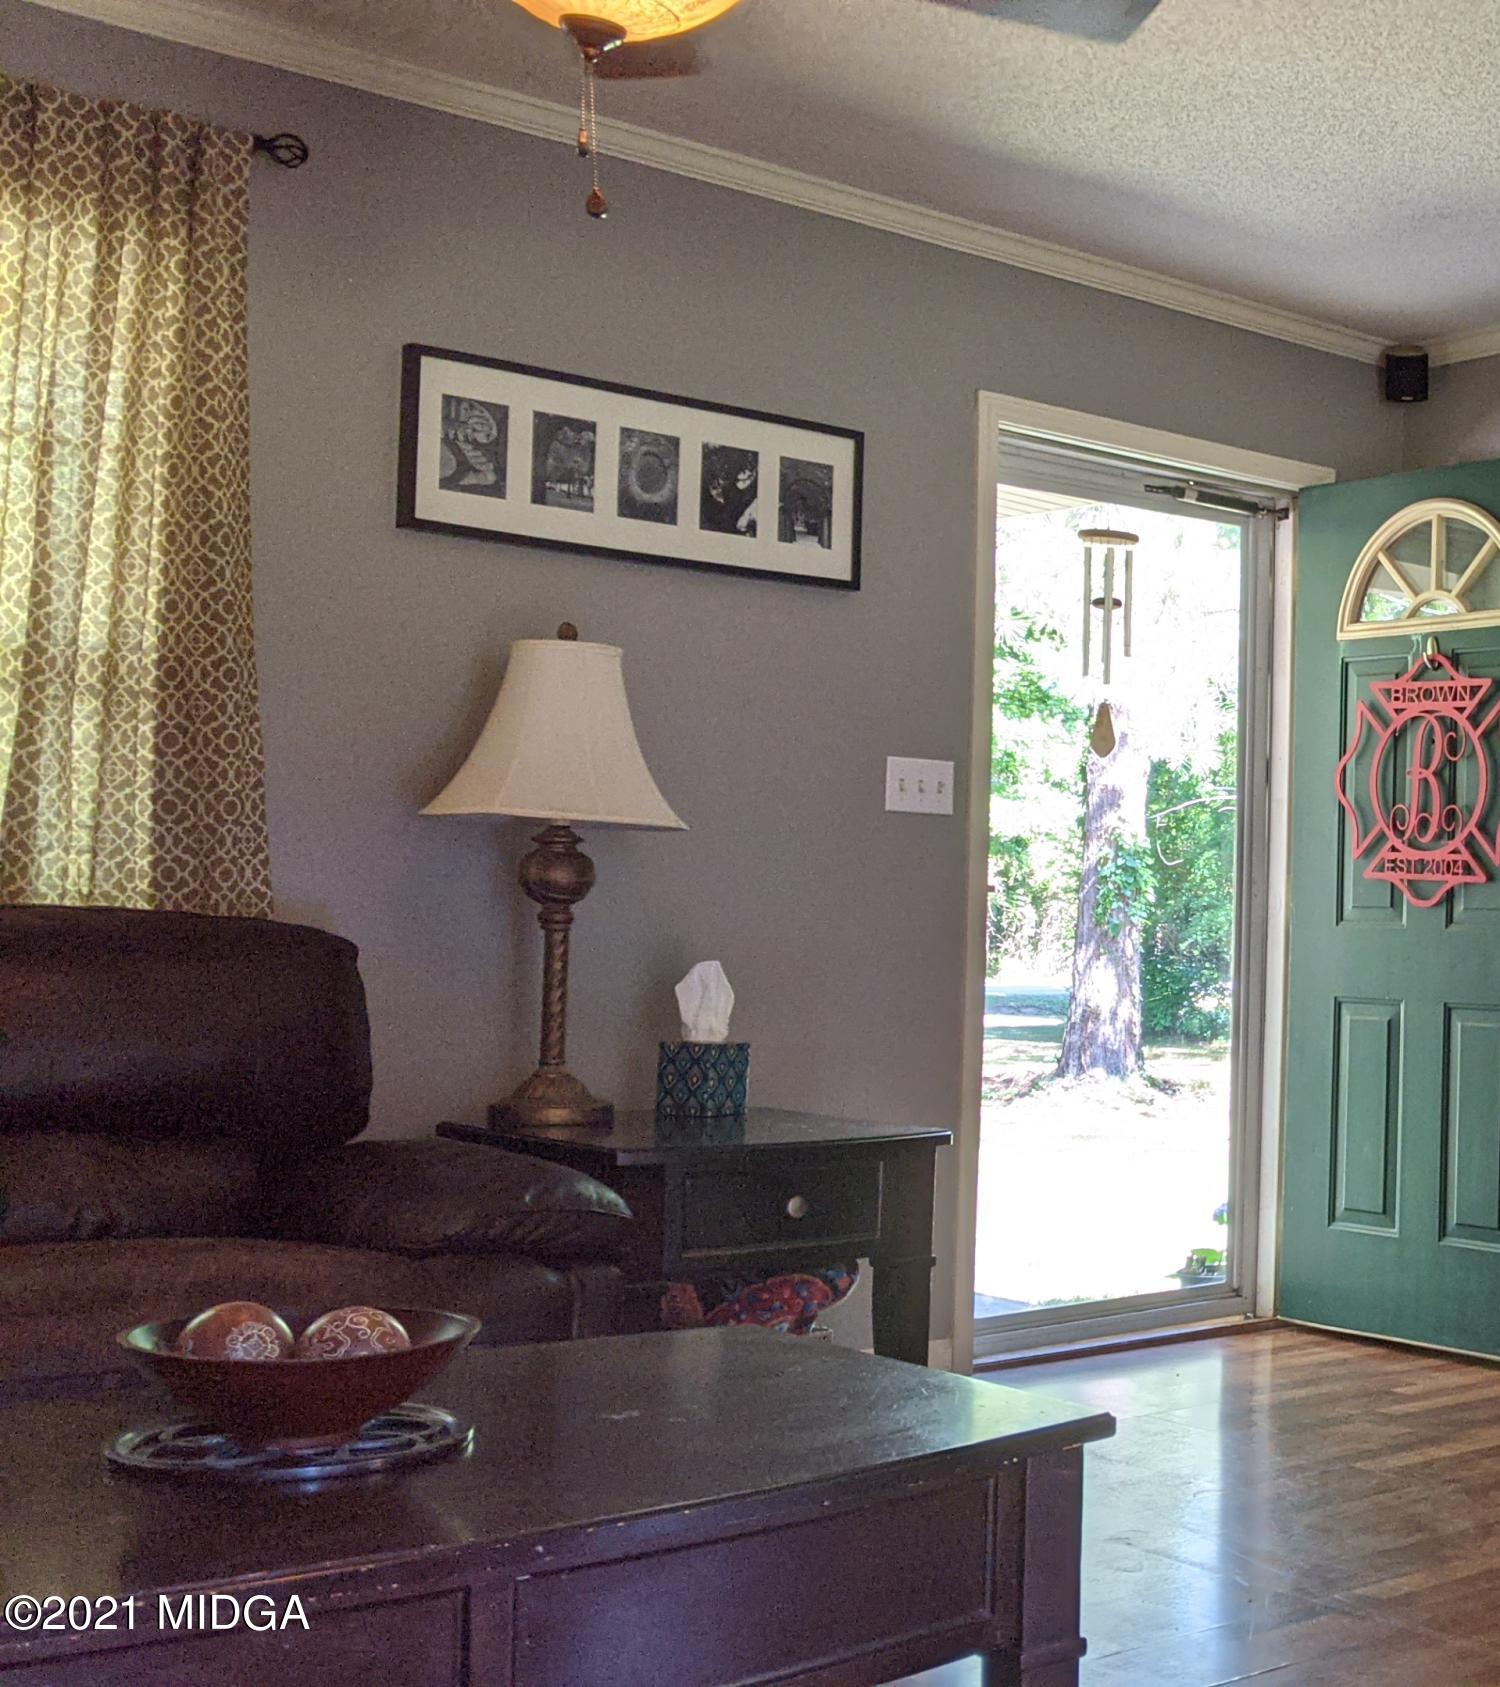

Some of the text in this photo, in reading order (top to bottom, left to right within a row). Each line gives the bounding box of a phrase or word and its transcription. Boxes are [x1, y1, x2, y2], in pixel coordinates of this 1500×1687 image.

[1391, 685, 1470, 704] BROWN
[1384, 857, 1464, 876] EST 2004
